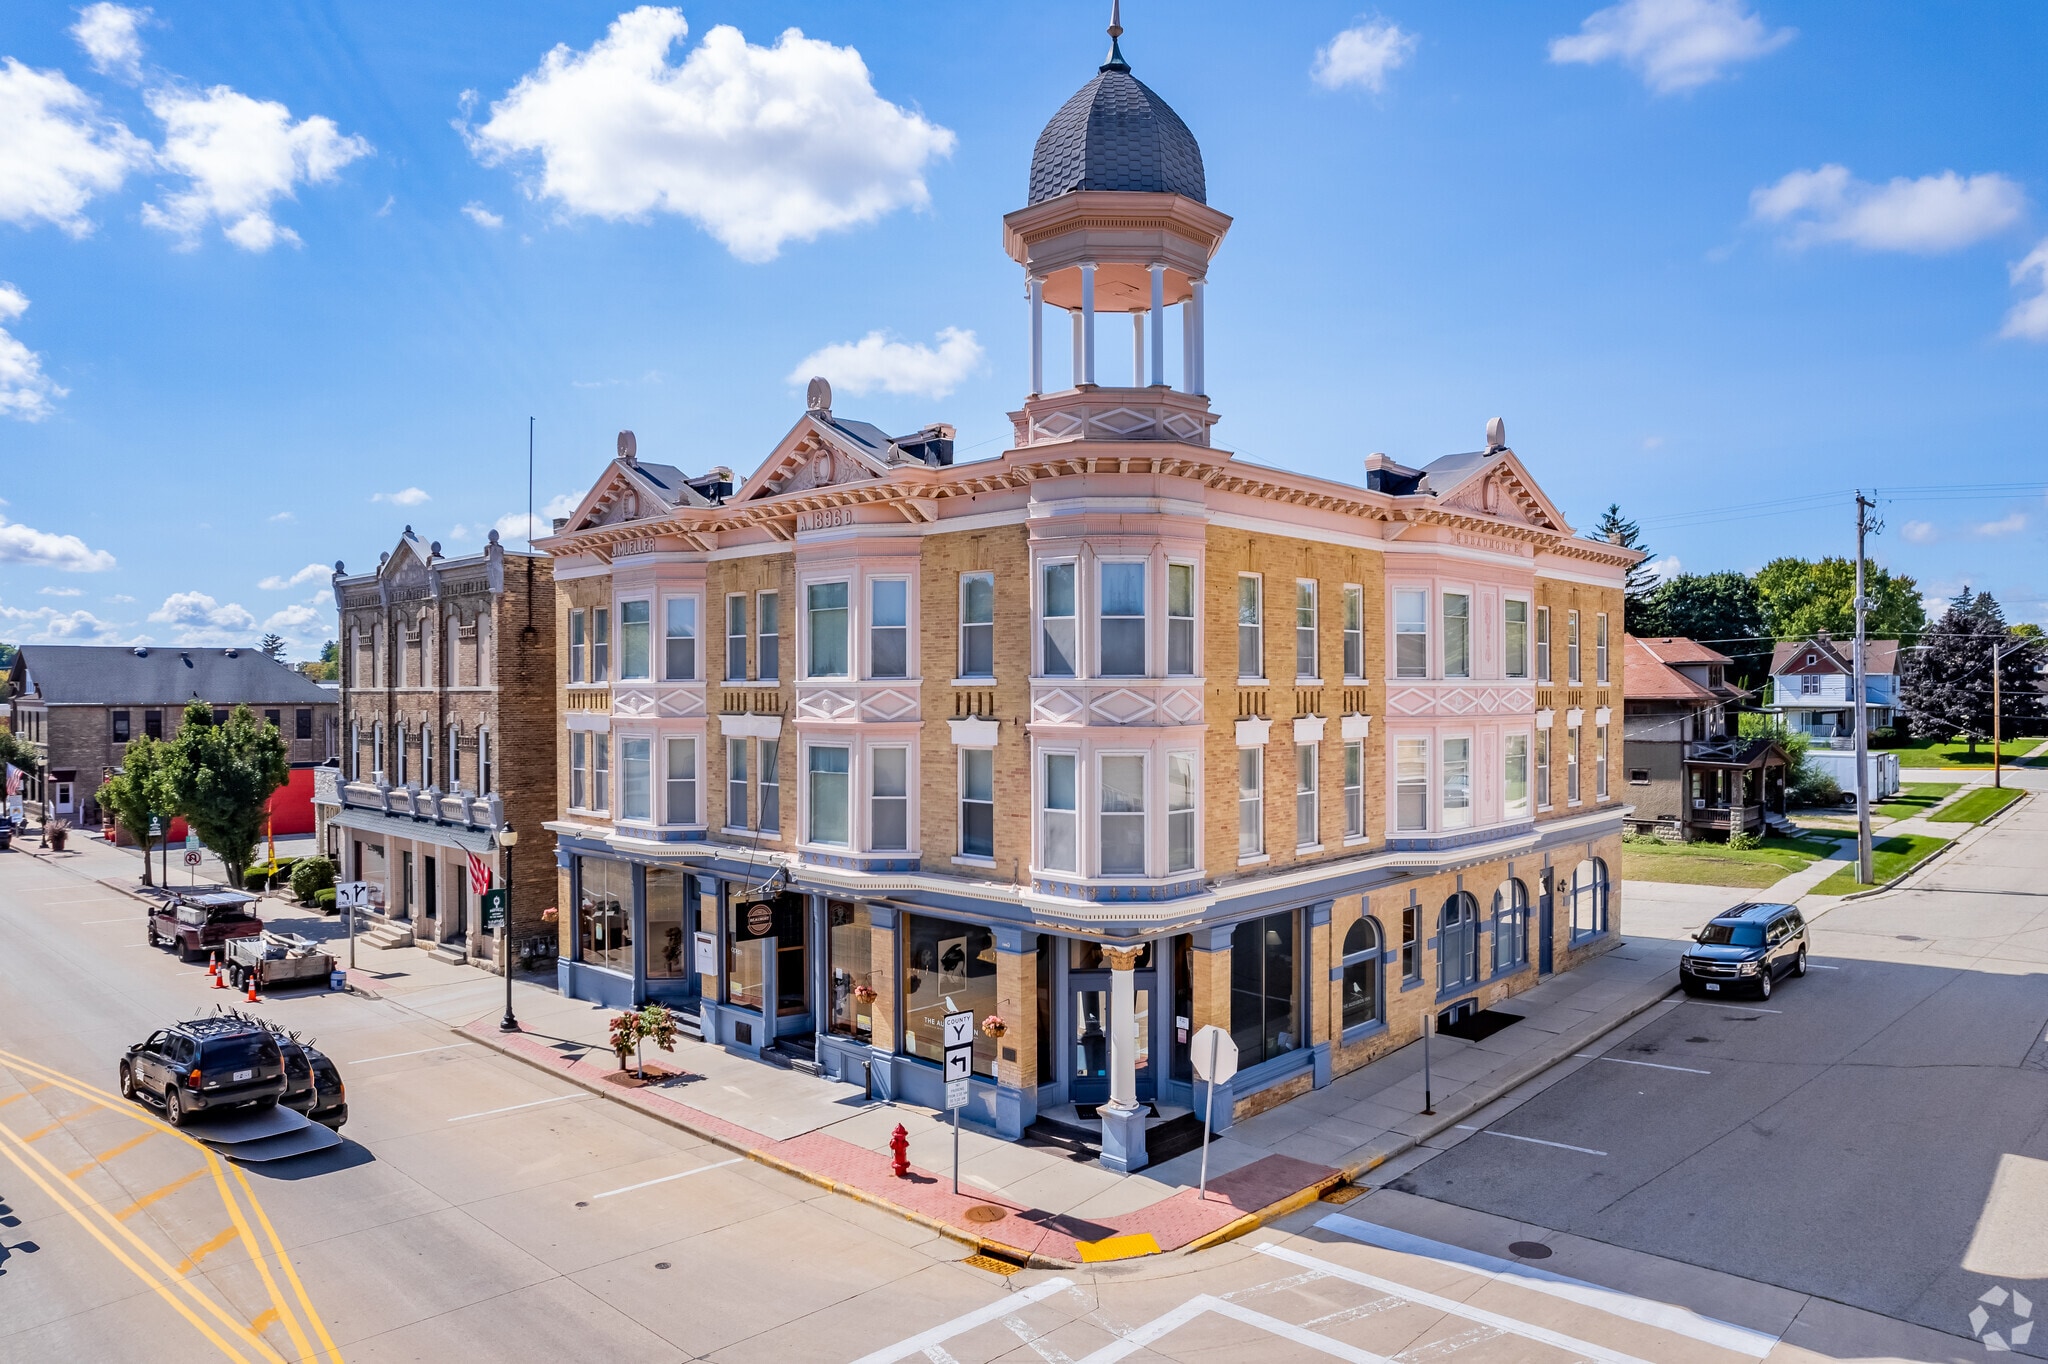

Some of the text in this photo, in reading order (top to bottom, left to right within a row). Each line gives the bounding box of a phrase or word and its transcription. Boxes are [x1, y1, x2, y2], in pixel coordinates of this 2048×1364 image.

[810, 509, 841, 530] 1896
[924, 1016, 935, 1025] THE
[946, 1015, 971, 1026] COUNTY
[953, 1023, 965, 1041] Y
